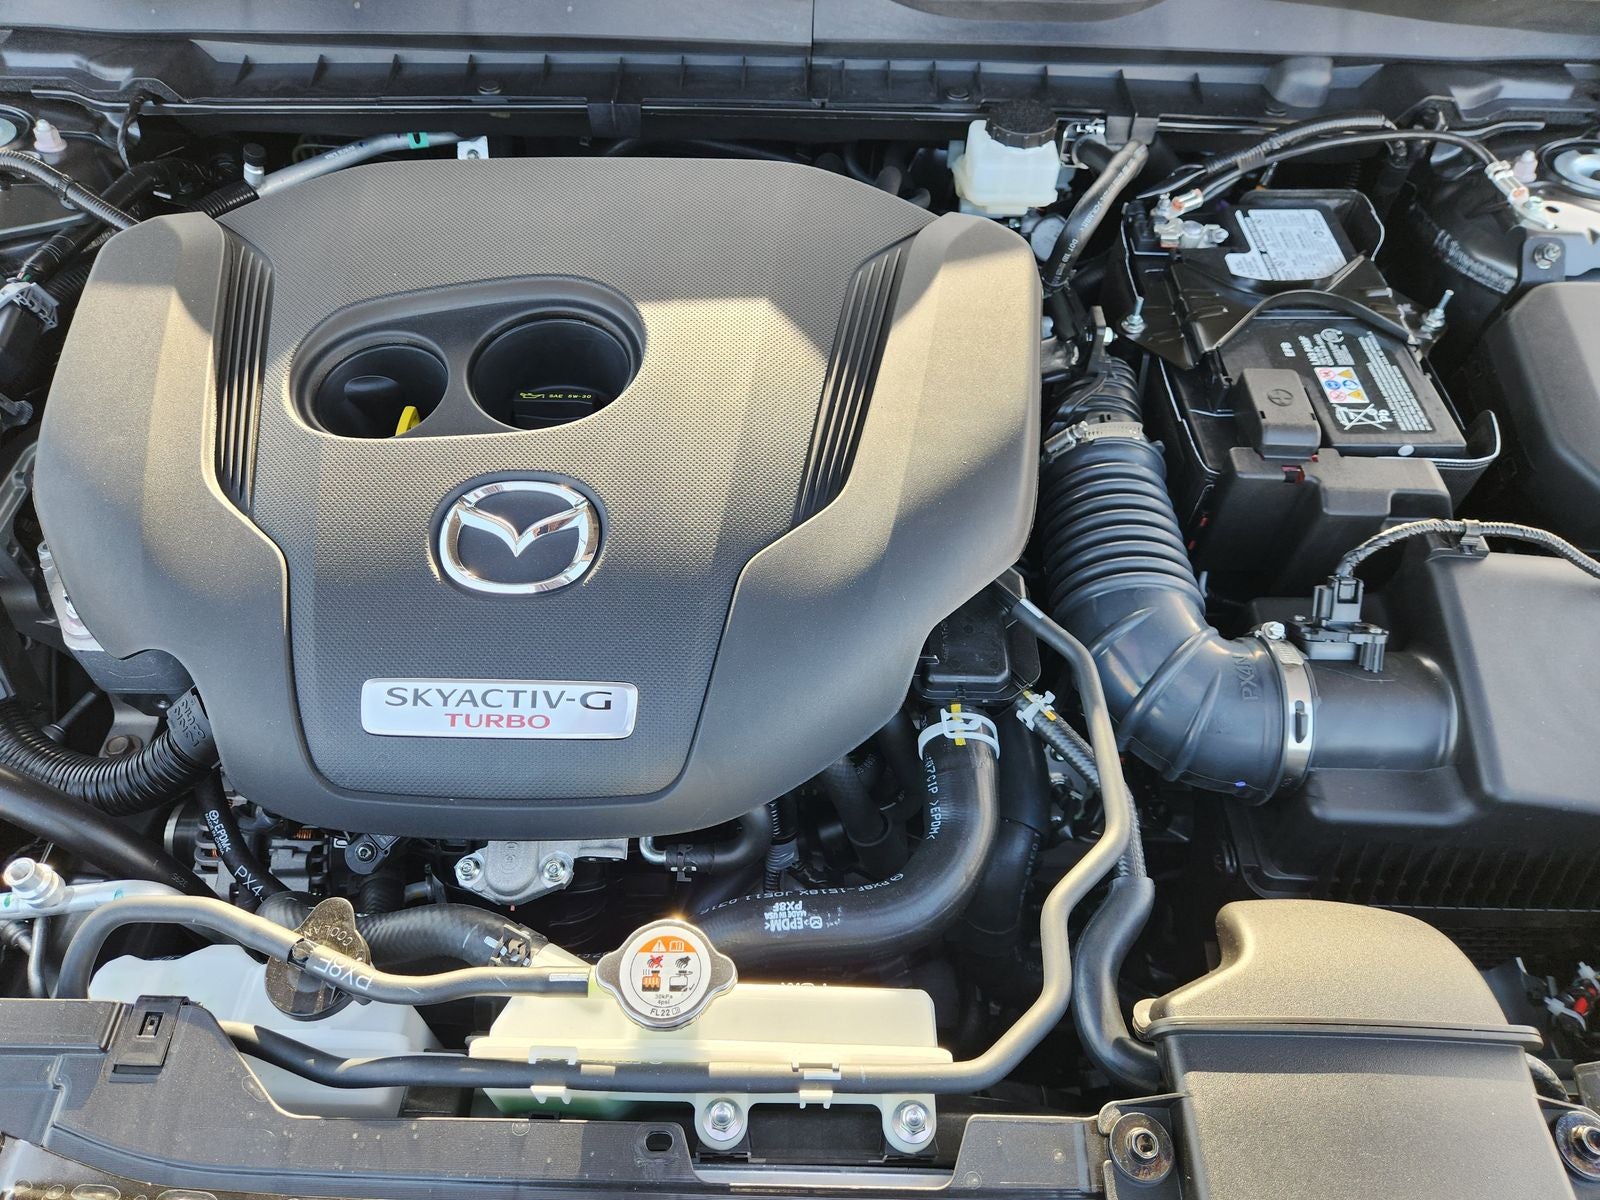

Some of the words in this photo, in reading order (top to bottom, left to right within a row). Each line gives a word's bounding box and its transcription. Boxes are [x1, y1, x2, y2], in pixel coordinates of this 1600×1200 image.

[384, 687, 612, 711] SKYACTIV-G
[444, 713, 551, 729] TURBO
[234, 864, 264, 903] PX4
[772, 900, 803, 912] PX8F
[764, 911, 778, 920] USA
[787, 910, 807, 918] MADE
[303, 921, 353, 947] COOLAN
[650, 1007, 671, 1017] FL22
